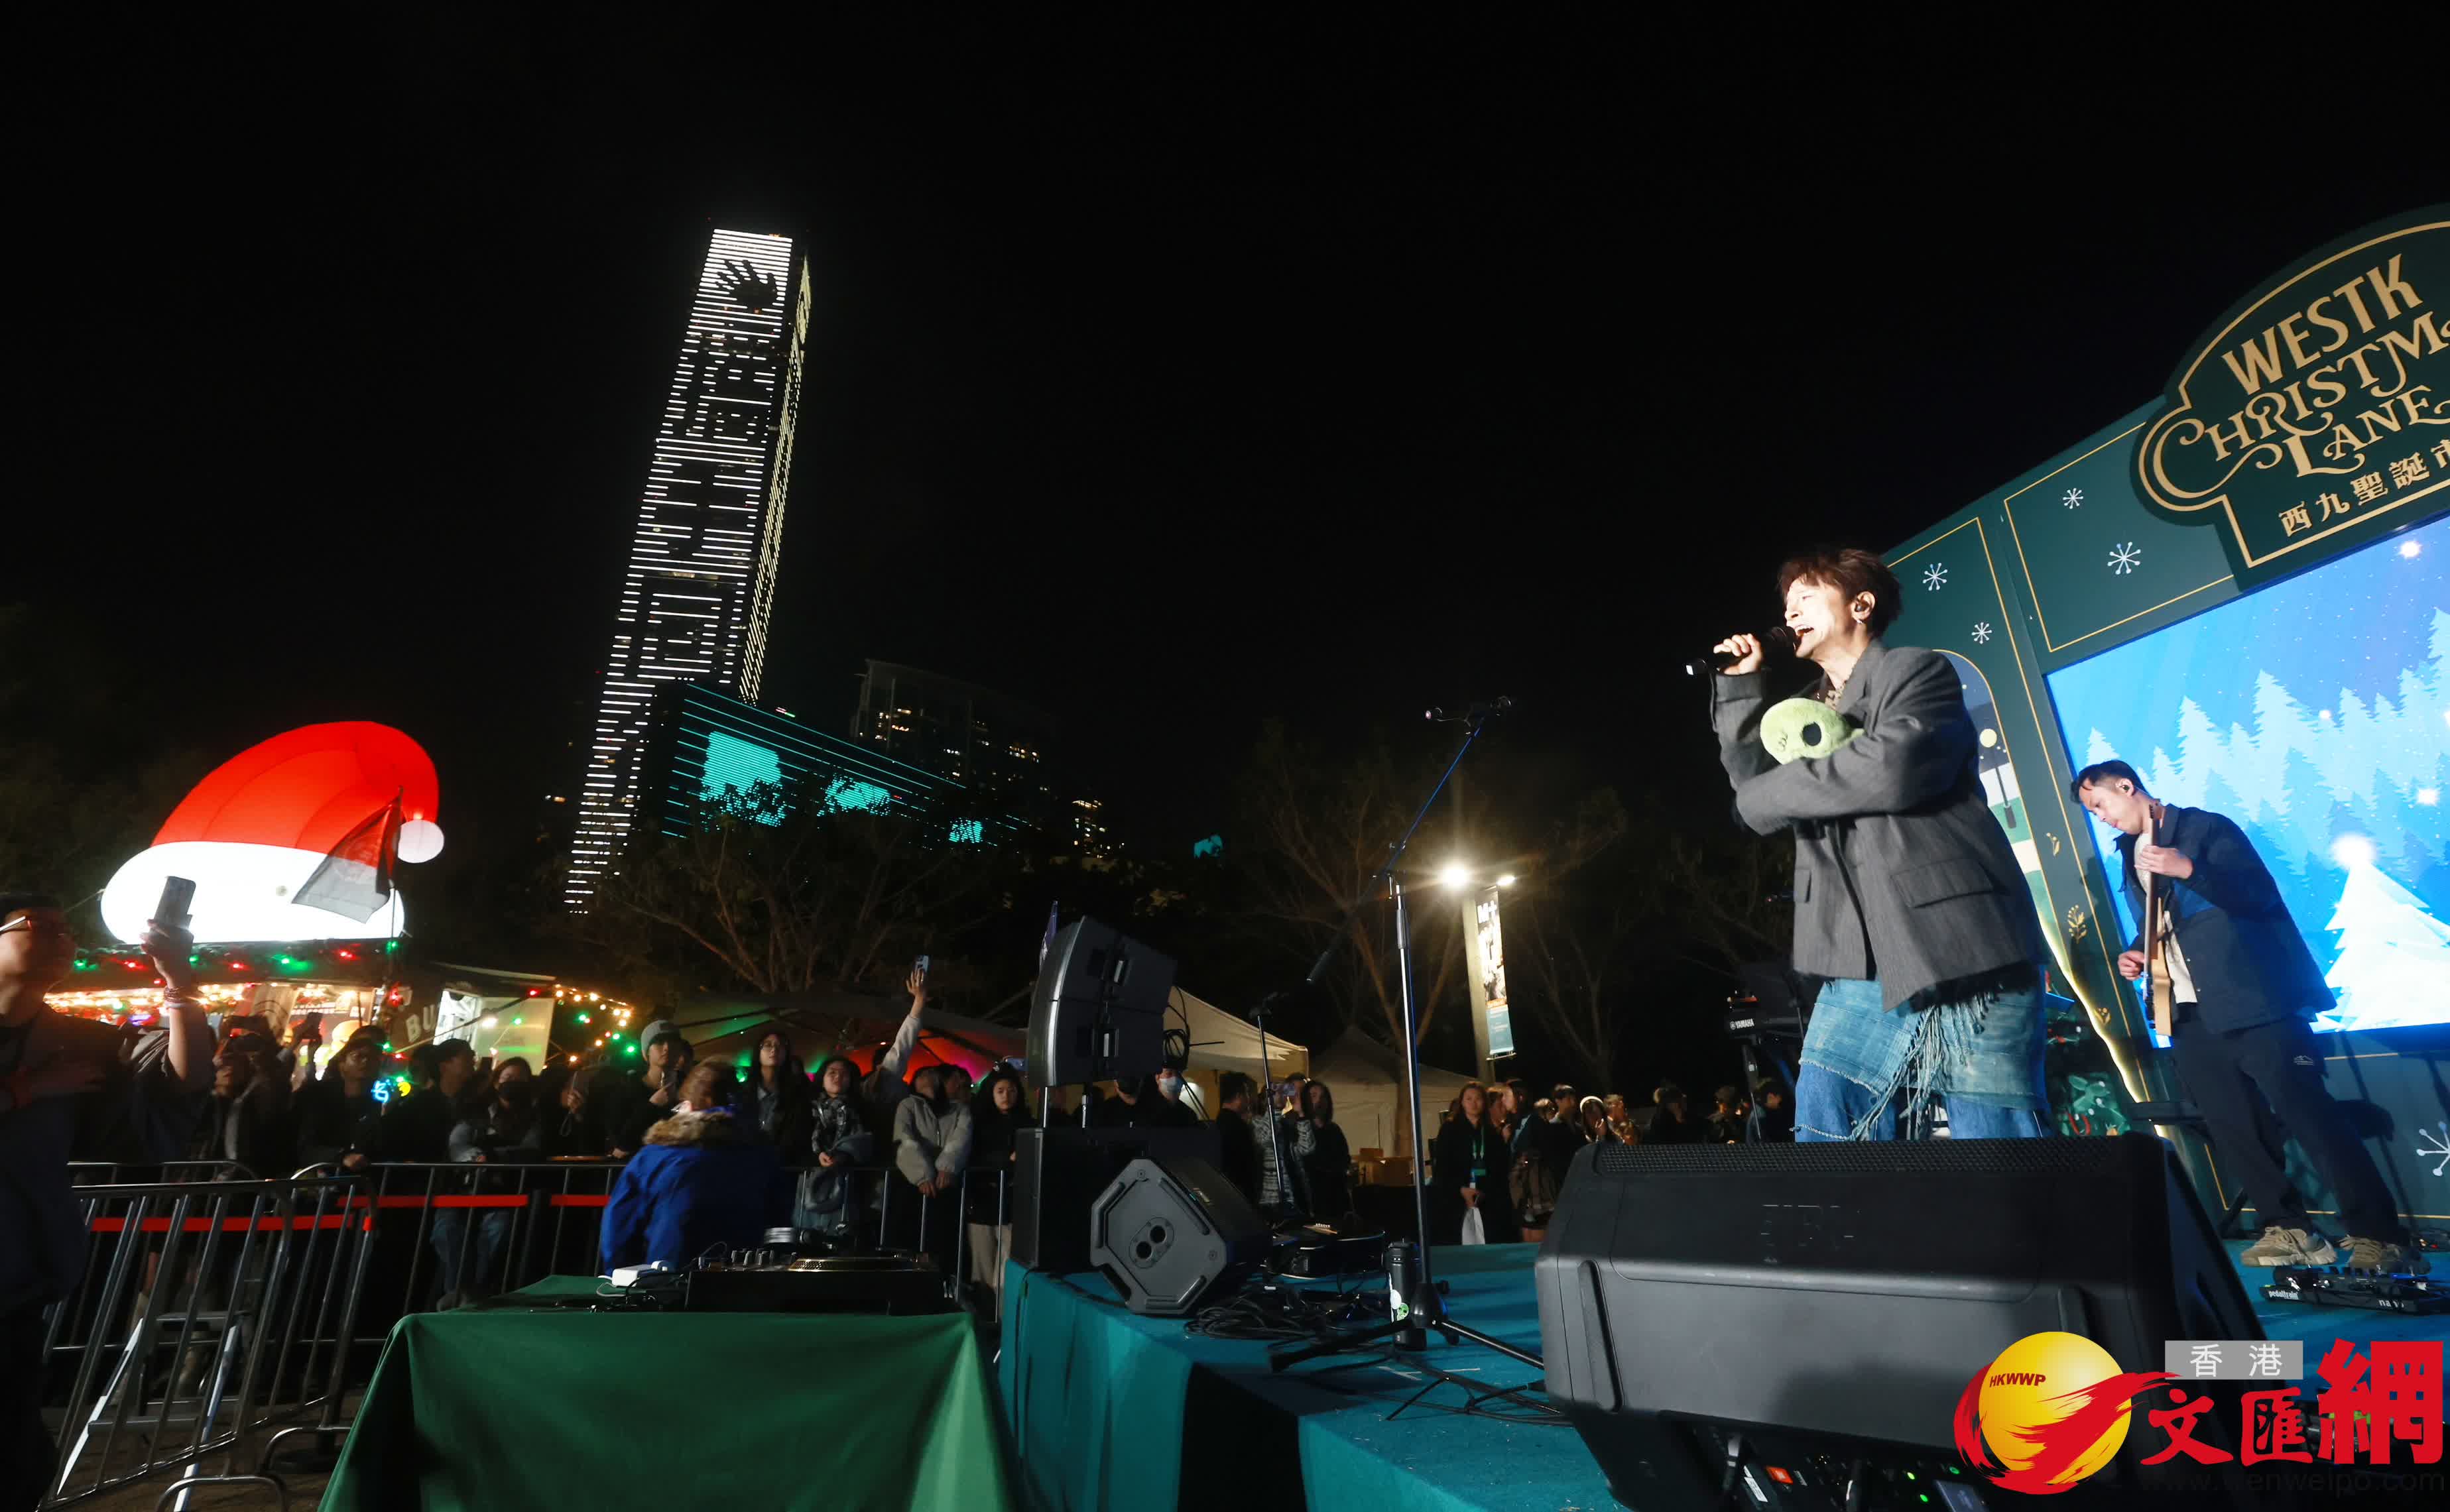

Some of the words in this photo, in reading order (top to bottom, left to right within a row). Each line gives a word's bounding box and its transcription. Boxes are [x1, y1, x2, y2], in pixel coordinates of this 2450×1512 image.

[2221, 253, 2423, 396] WESTK
[2153, 311, 2450, 498] CHRISTM
[2282, 385, 2450, 478] LANE
[1735, 1018, 1755, 1029] YAMAHA
